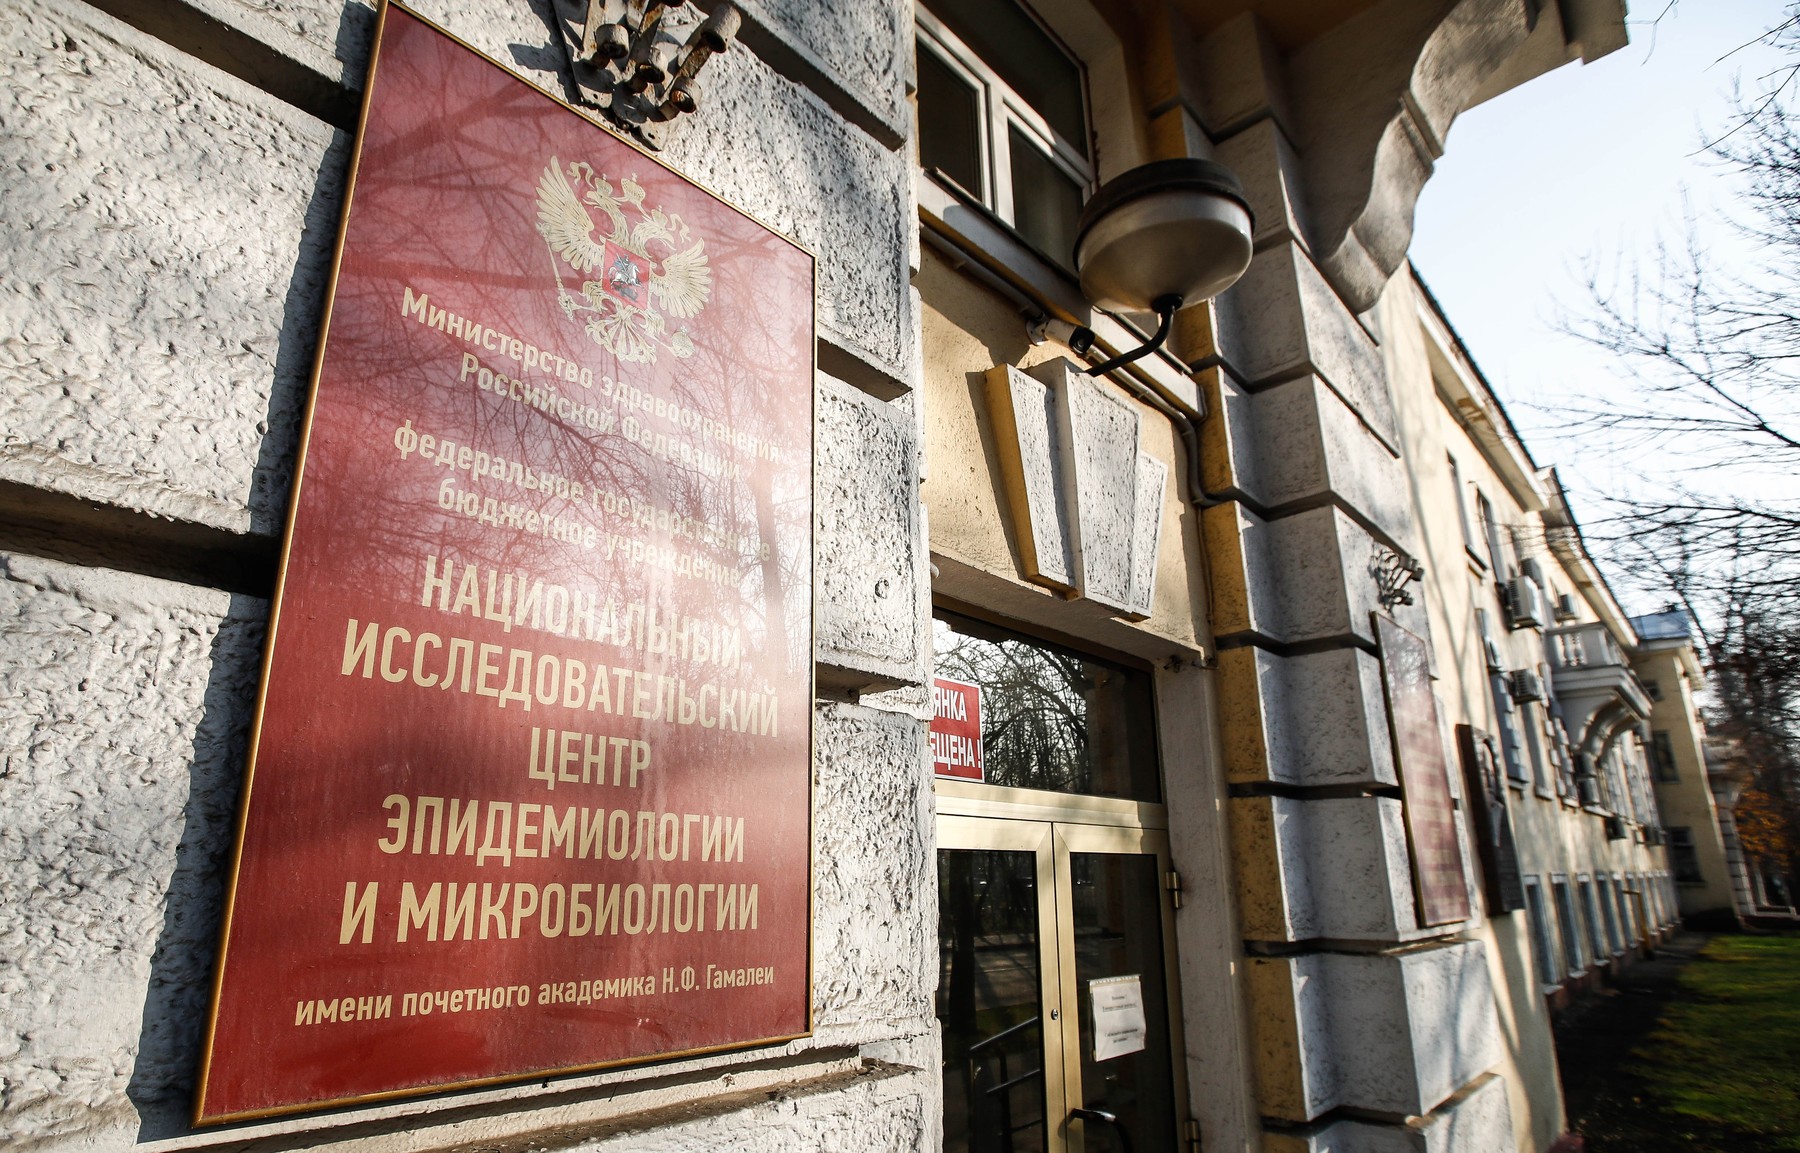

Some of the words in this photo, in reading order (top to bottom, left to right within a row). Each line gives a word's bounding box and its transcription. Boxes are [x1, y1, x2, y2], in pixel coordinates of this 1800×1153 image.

[401, 287, 593, 389] Министерство
[601, 376, 779, 464] здравоохранения
[460, 352, 614, 435] Российской
[394, 420, 584, 503] федеральное
[438, 477, 597, 549] бюджетное
[605, 531, 740, 588] учреждение
[422, 555, 741, 669] НАЦИОНАЛЬНЫЙ
[341, 618, 778, 738] ИССЛЕДОВАТЕЛЬСКИЙ
[528, 727, 652, 790] ЦЕНТР
[378, 794, 745, 867] ЭПИДЕМИОЛОГИИ
[339, 881, 379, 945] И
[396, 882, 759, 943] МИКРОБИОЛОГИИ
[295, 993, 392, 1026] имени
[401, 981, 530, 1017] почетного
[538, 971, 655, 1005] академика
[706, 964, 774, 990] Гамалеи
